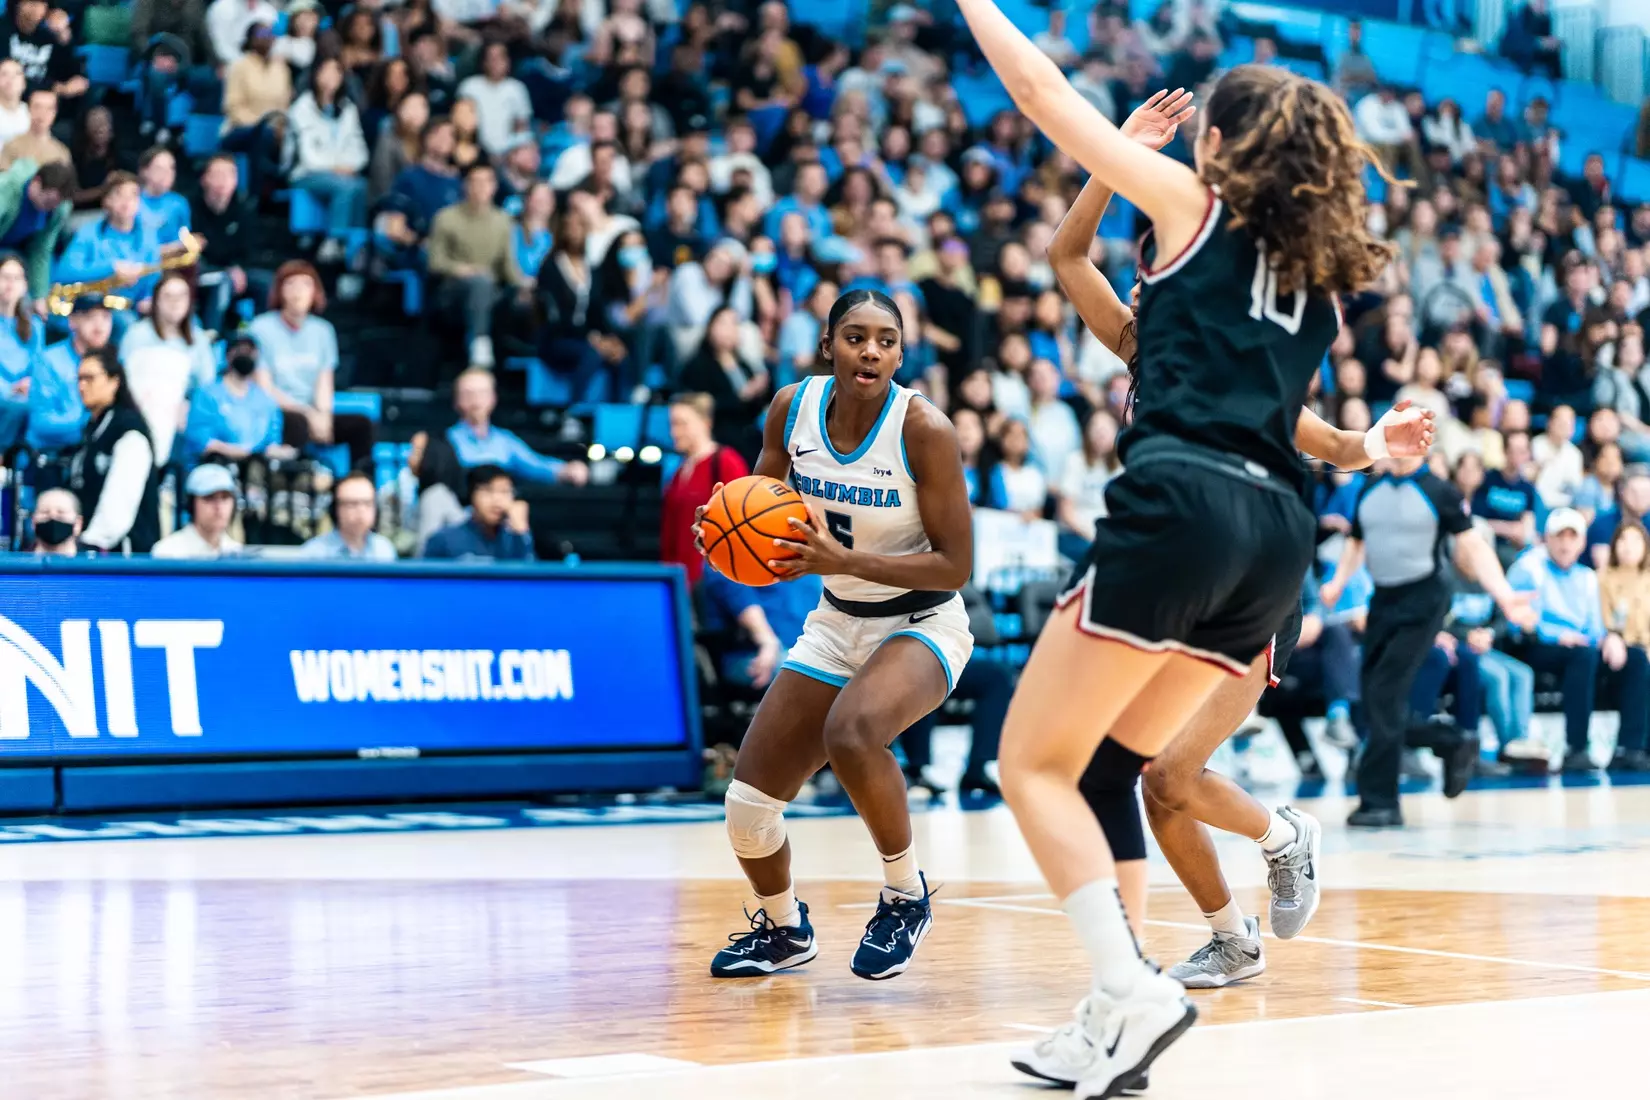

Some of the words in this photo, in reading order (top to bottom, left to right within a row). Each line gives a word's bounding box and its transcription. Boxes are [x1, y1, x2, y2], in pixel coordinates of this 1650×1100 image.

[795, 472, 901, 507] COLUMBIA
[873, 467, 886, 477] Ivy
[289, 649, 574, 702] WOMENSNIT.COM
